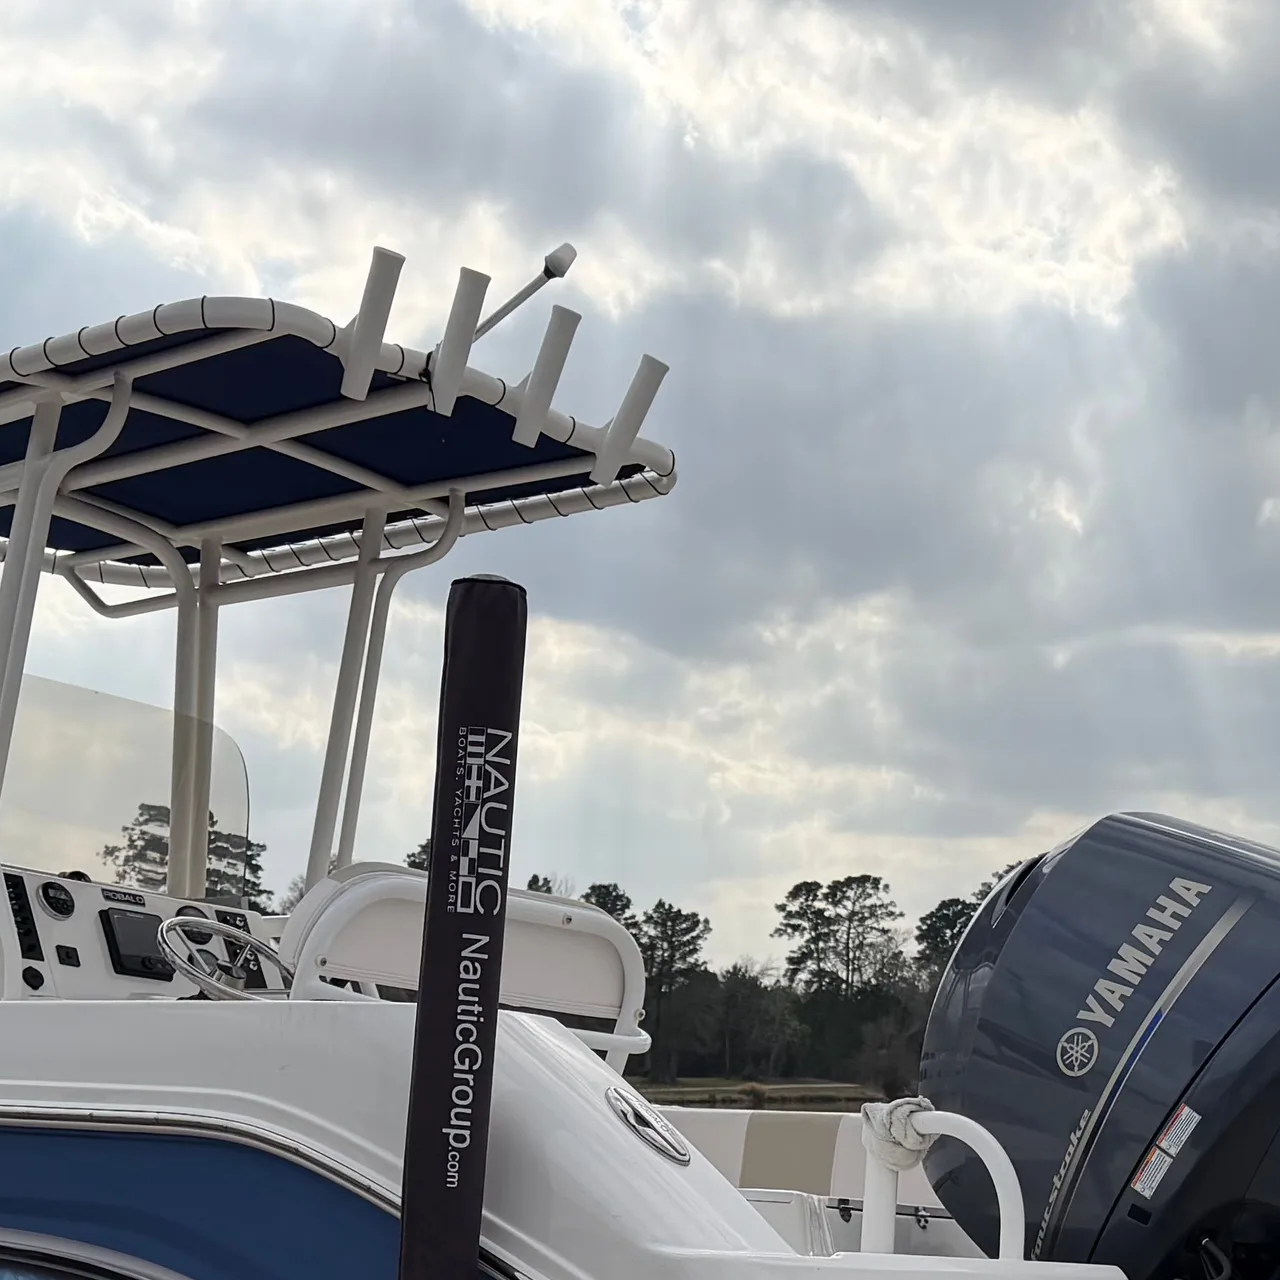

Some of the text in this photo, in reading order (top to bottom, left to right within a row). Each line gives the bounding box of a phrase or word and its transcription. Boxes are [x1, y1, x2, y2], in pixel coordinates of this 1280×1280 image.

[447, 870, 457, 912] MORE
[451, 789, 463, 846] YACHTS
[475, 728, 513, 915] NAUTIC
[1076, 876, 1212, 1028] YAMAHA
[442, 933, 490, 1188] NauticGroup.com
